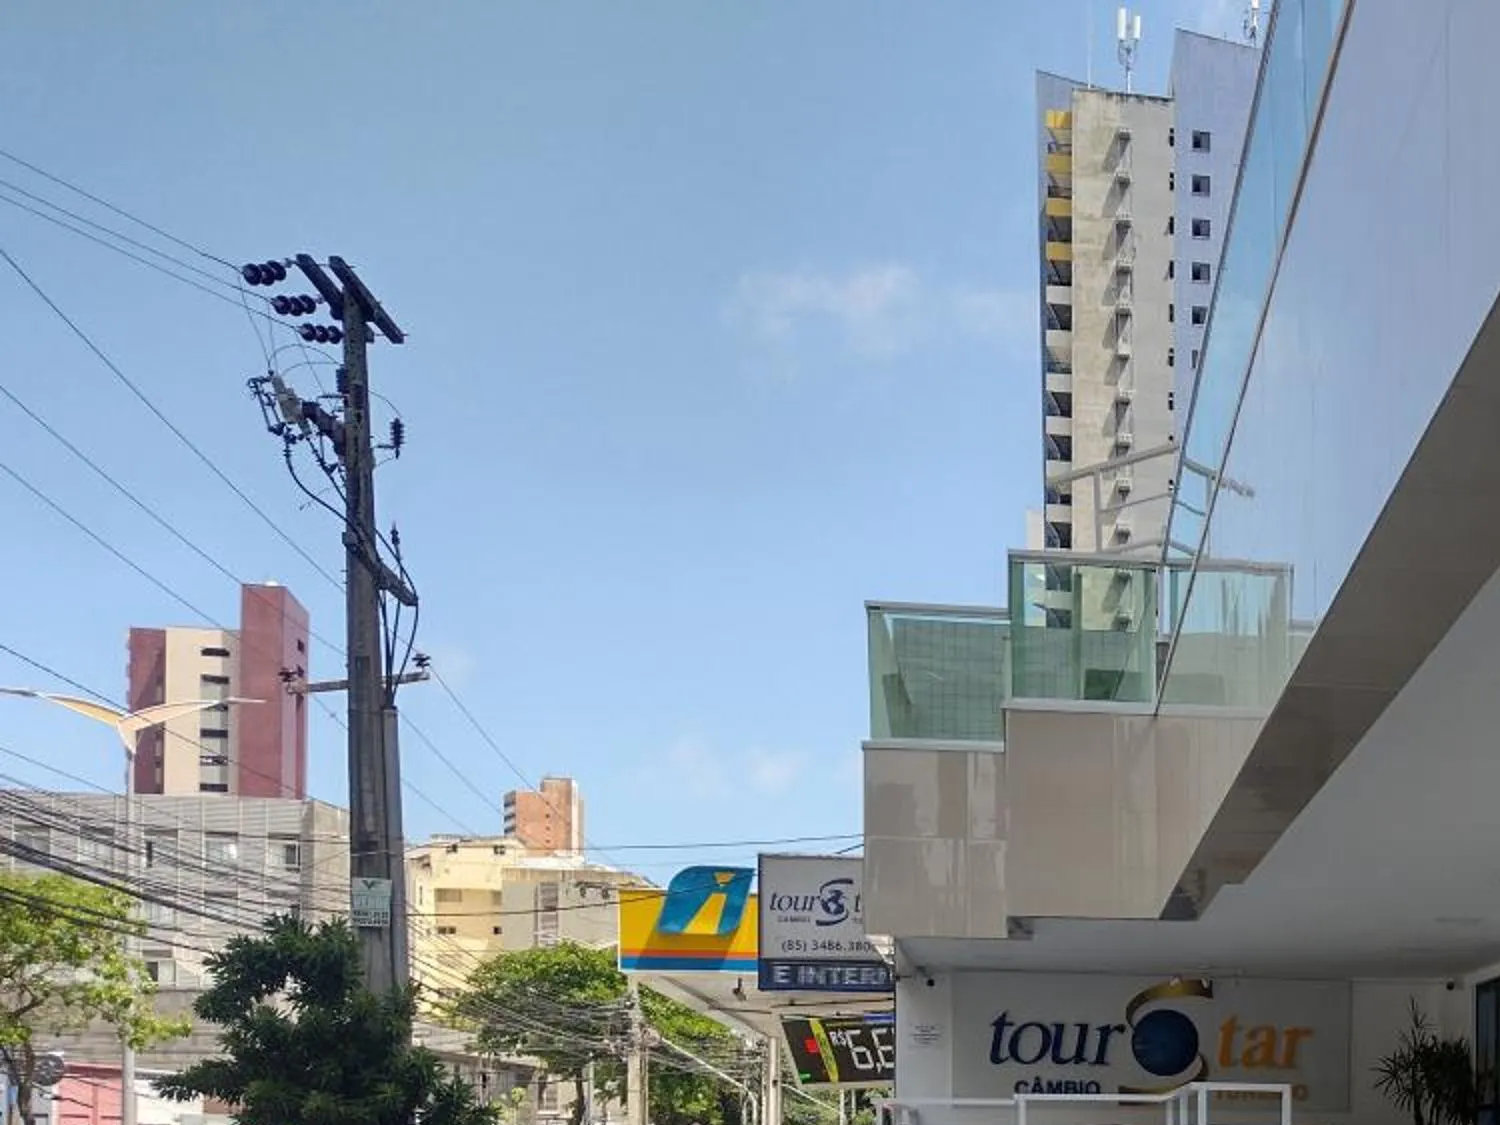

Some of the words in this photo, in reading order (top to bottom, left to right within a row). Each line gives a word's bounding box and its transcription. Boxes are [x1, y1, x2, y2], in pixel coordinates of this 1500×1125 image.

[781, 938, 807, 952] (85)
[772, 965, 791, 983] E
[1013, 1075, 1101, 1095] CÂMBIO
